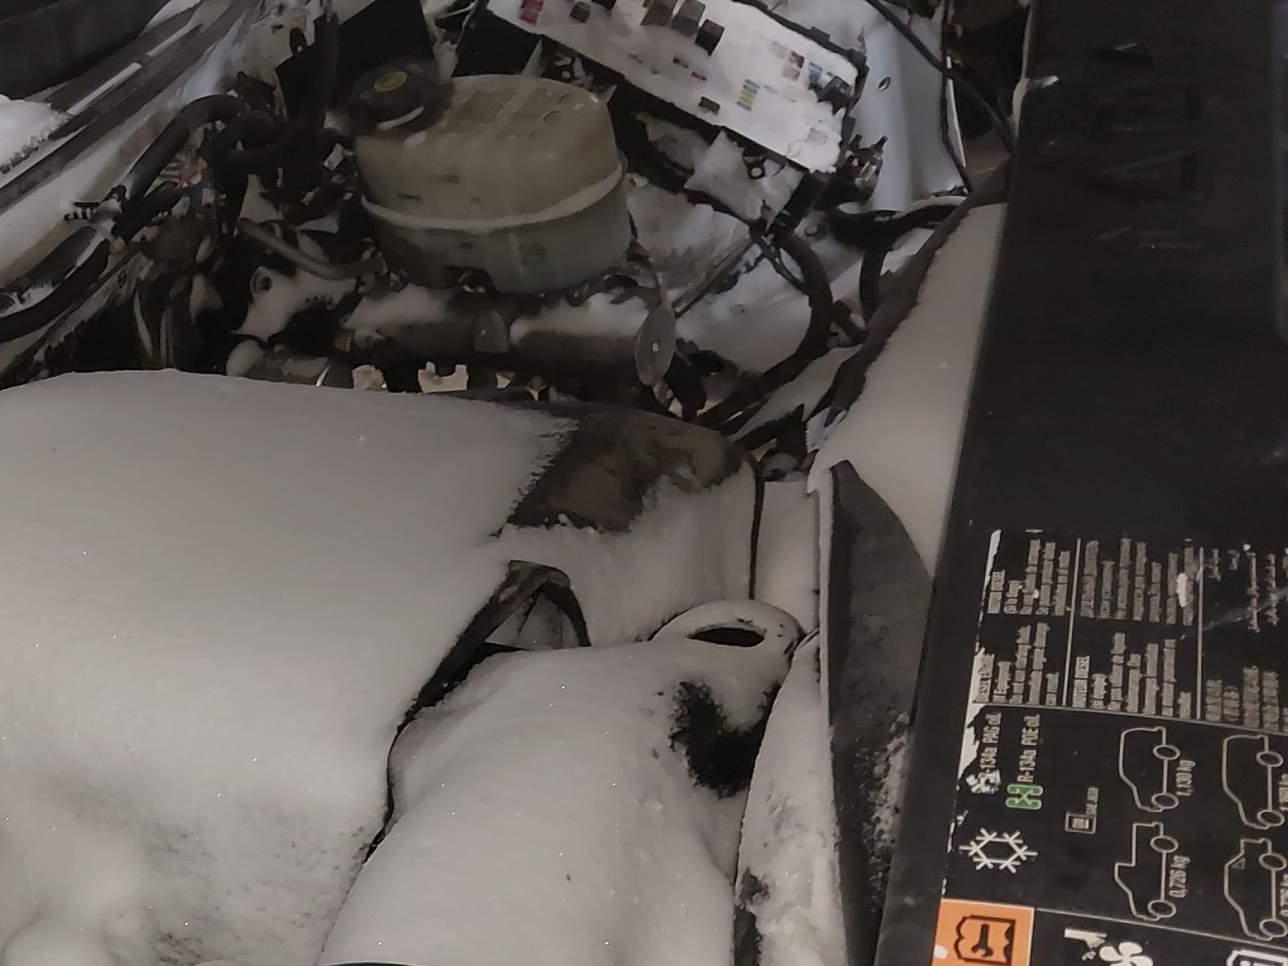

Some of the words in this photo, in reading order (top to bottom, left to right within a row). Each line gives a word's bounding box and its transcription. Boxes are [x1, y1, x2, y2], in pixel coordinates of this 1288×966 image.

[982, 726, 1000, 744] PAG
[1020, 728, 1039, 746] POE
[1016, 749, 1038, 783] R-134a
[1178, 760, 1196, 774] kg
[1170, 855, 1191, 869] kg
